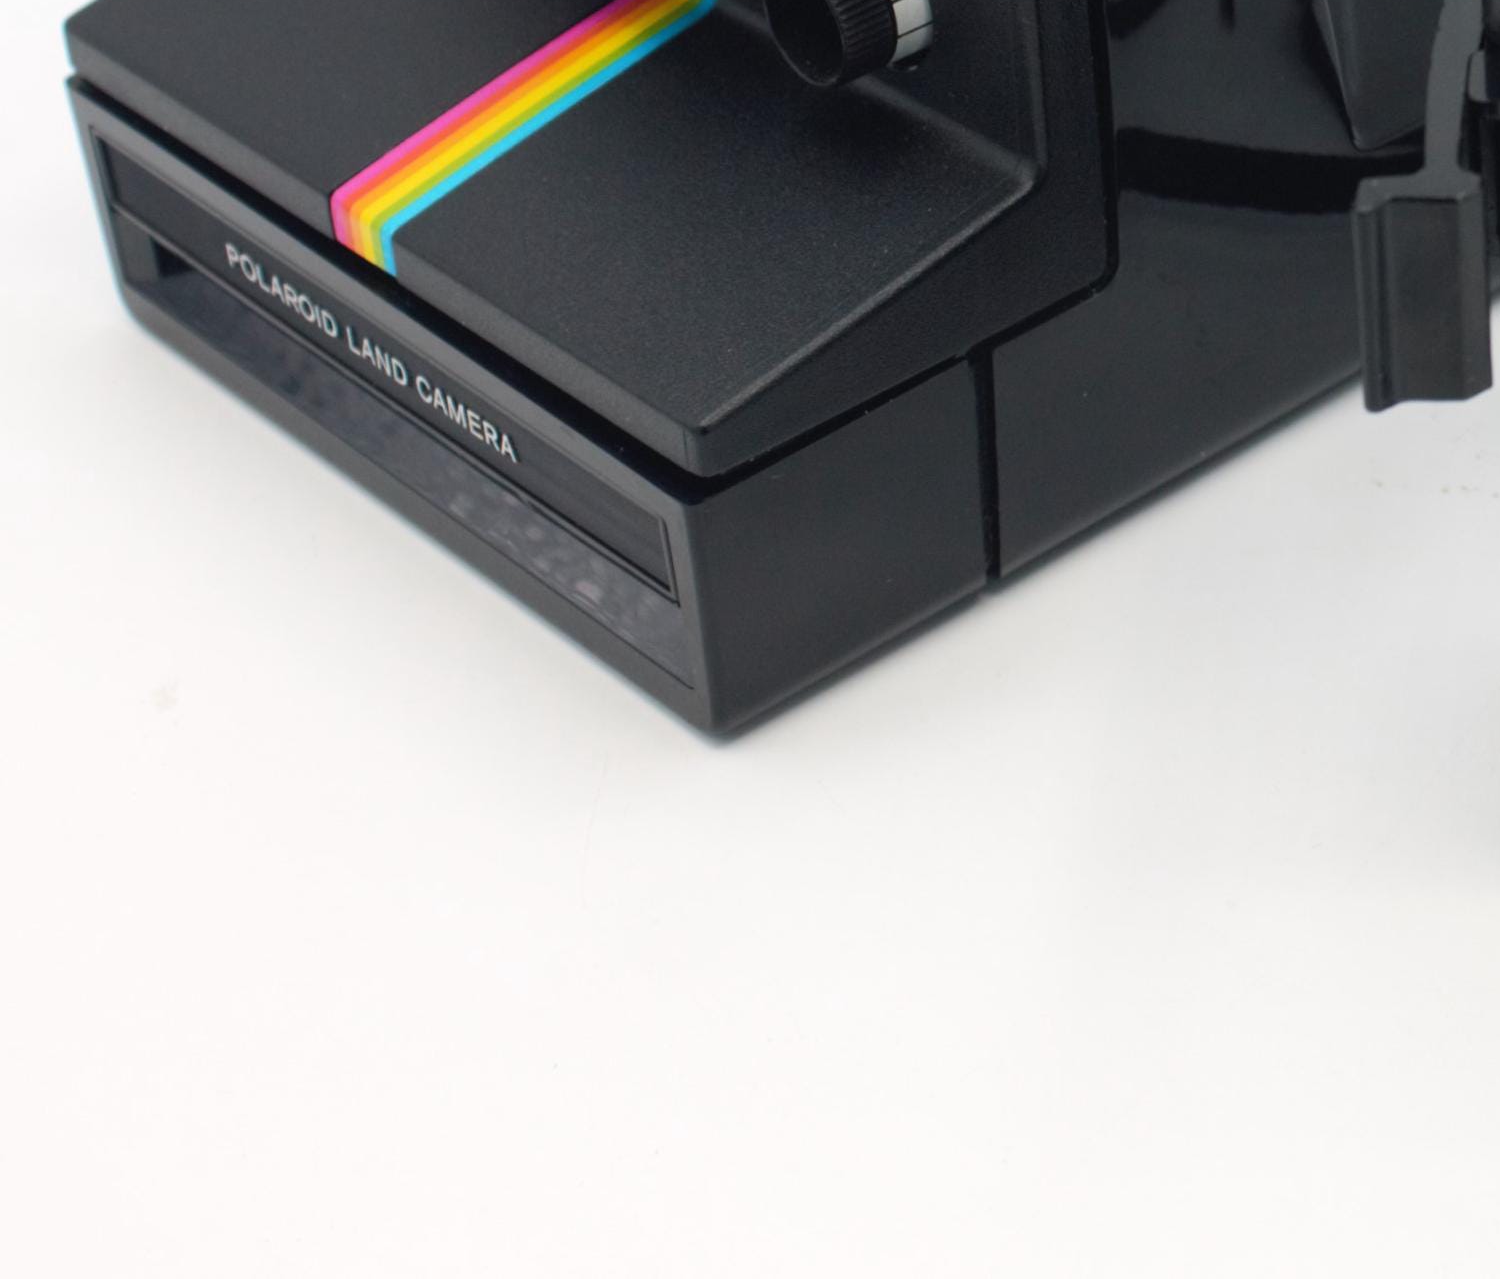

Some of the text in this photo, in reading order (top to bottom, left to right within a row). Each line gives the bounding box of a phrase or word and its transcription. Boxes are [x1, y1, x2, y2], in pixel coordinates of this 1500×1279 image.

[225, 242, 518, 464] POLAROID LAND CAMERA
